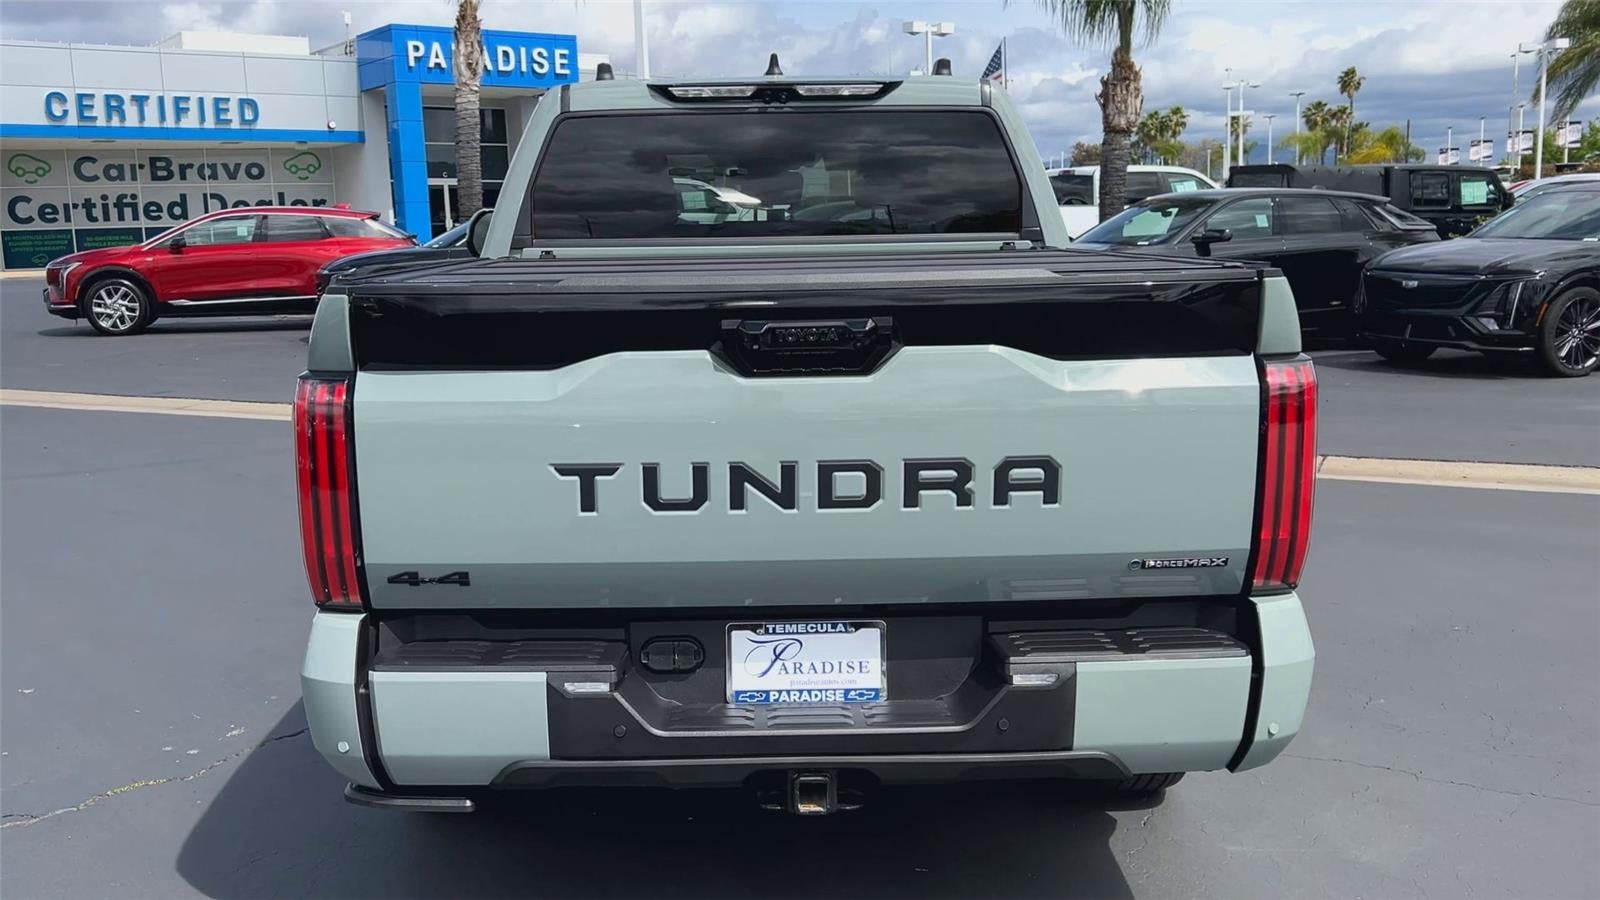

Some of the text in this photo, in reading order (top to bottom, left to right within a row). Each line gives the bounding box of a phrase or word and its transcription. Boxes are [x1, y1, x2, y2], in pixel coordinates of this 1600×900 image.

[407, 40, 570, 75] PADISE
[44, 91, 260, 126] CERTIFIED
[73, 156, 266, 183] CarBravo
[7, 193, 190, 226] Certified
[775, 327, 840, 343] TOYOTA
[548, 455, 1063, 516] TUNDRA
[766, 623, 846, 634] TEMECULA
[744, 637, 871, 678] PARADISE
[769, 690, 845, 703] PARADISE
